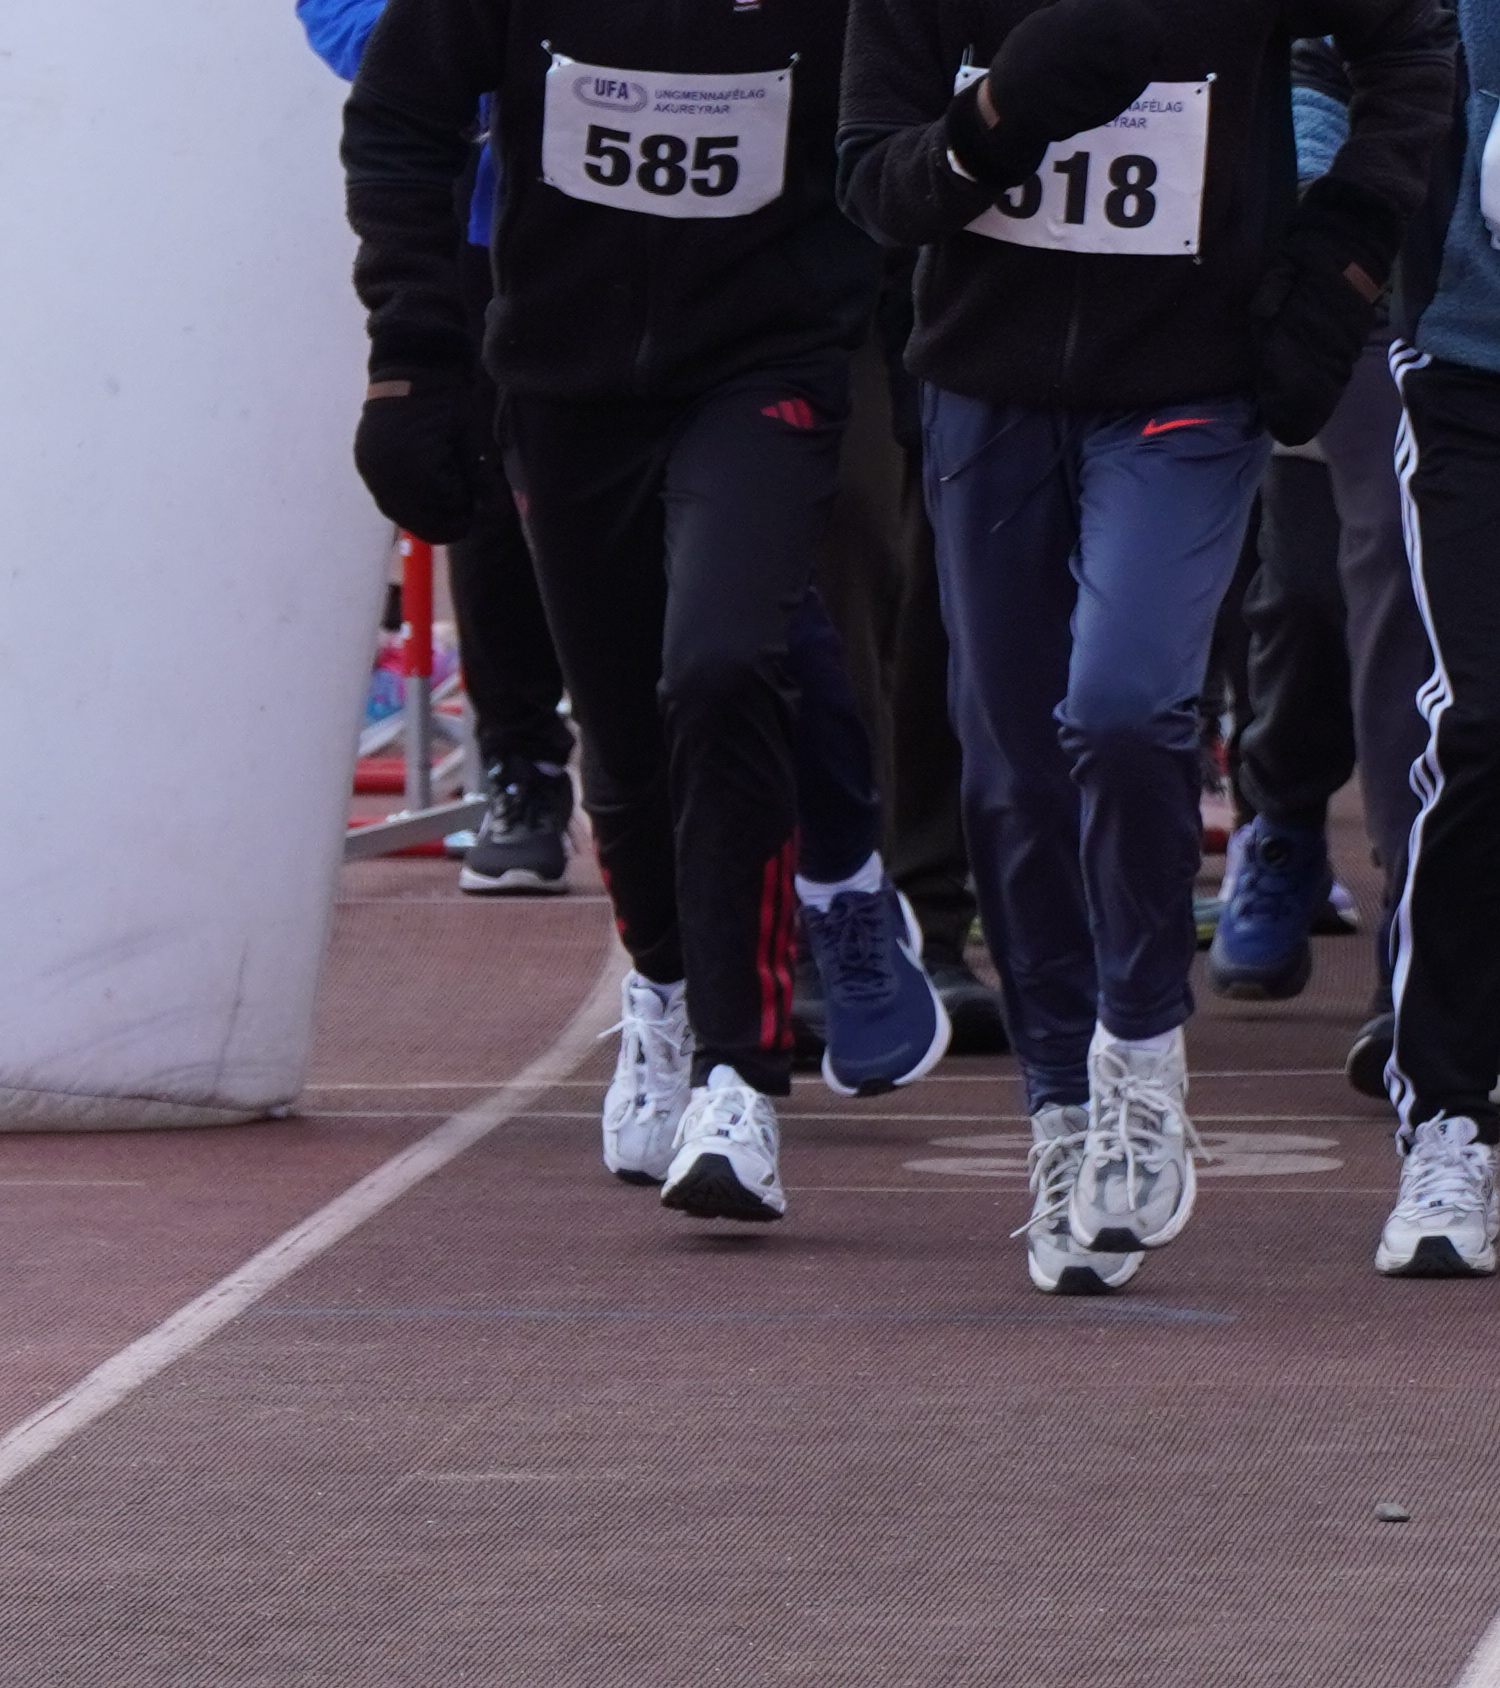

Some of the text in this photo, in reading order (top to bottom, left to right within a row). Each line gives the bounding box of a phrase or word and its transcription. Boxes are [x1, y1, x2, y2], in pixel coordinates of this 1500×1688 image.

[594, 77, 765, 101] UFA UNGMENNAFÉLAG
[653, 103, 730, 115] AKUREYRAR
[584, 124, 740, 198] 585
